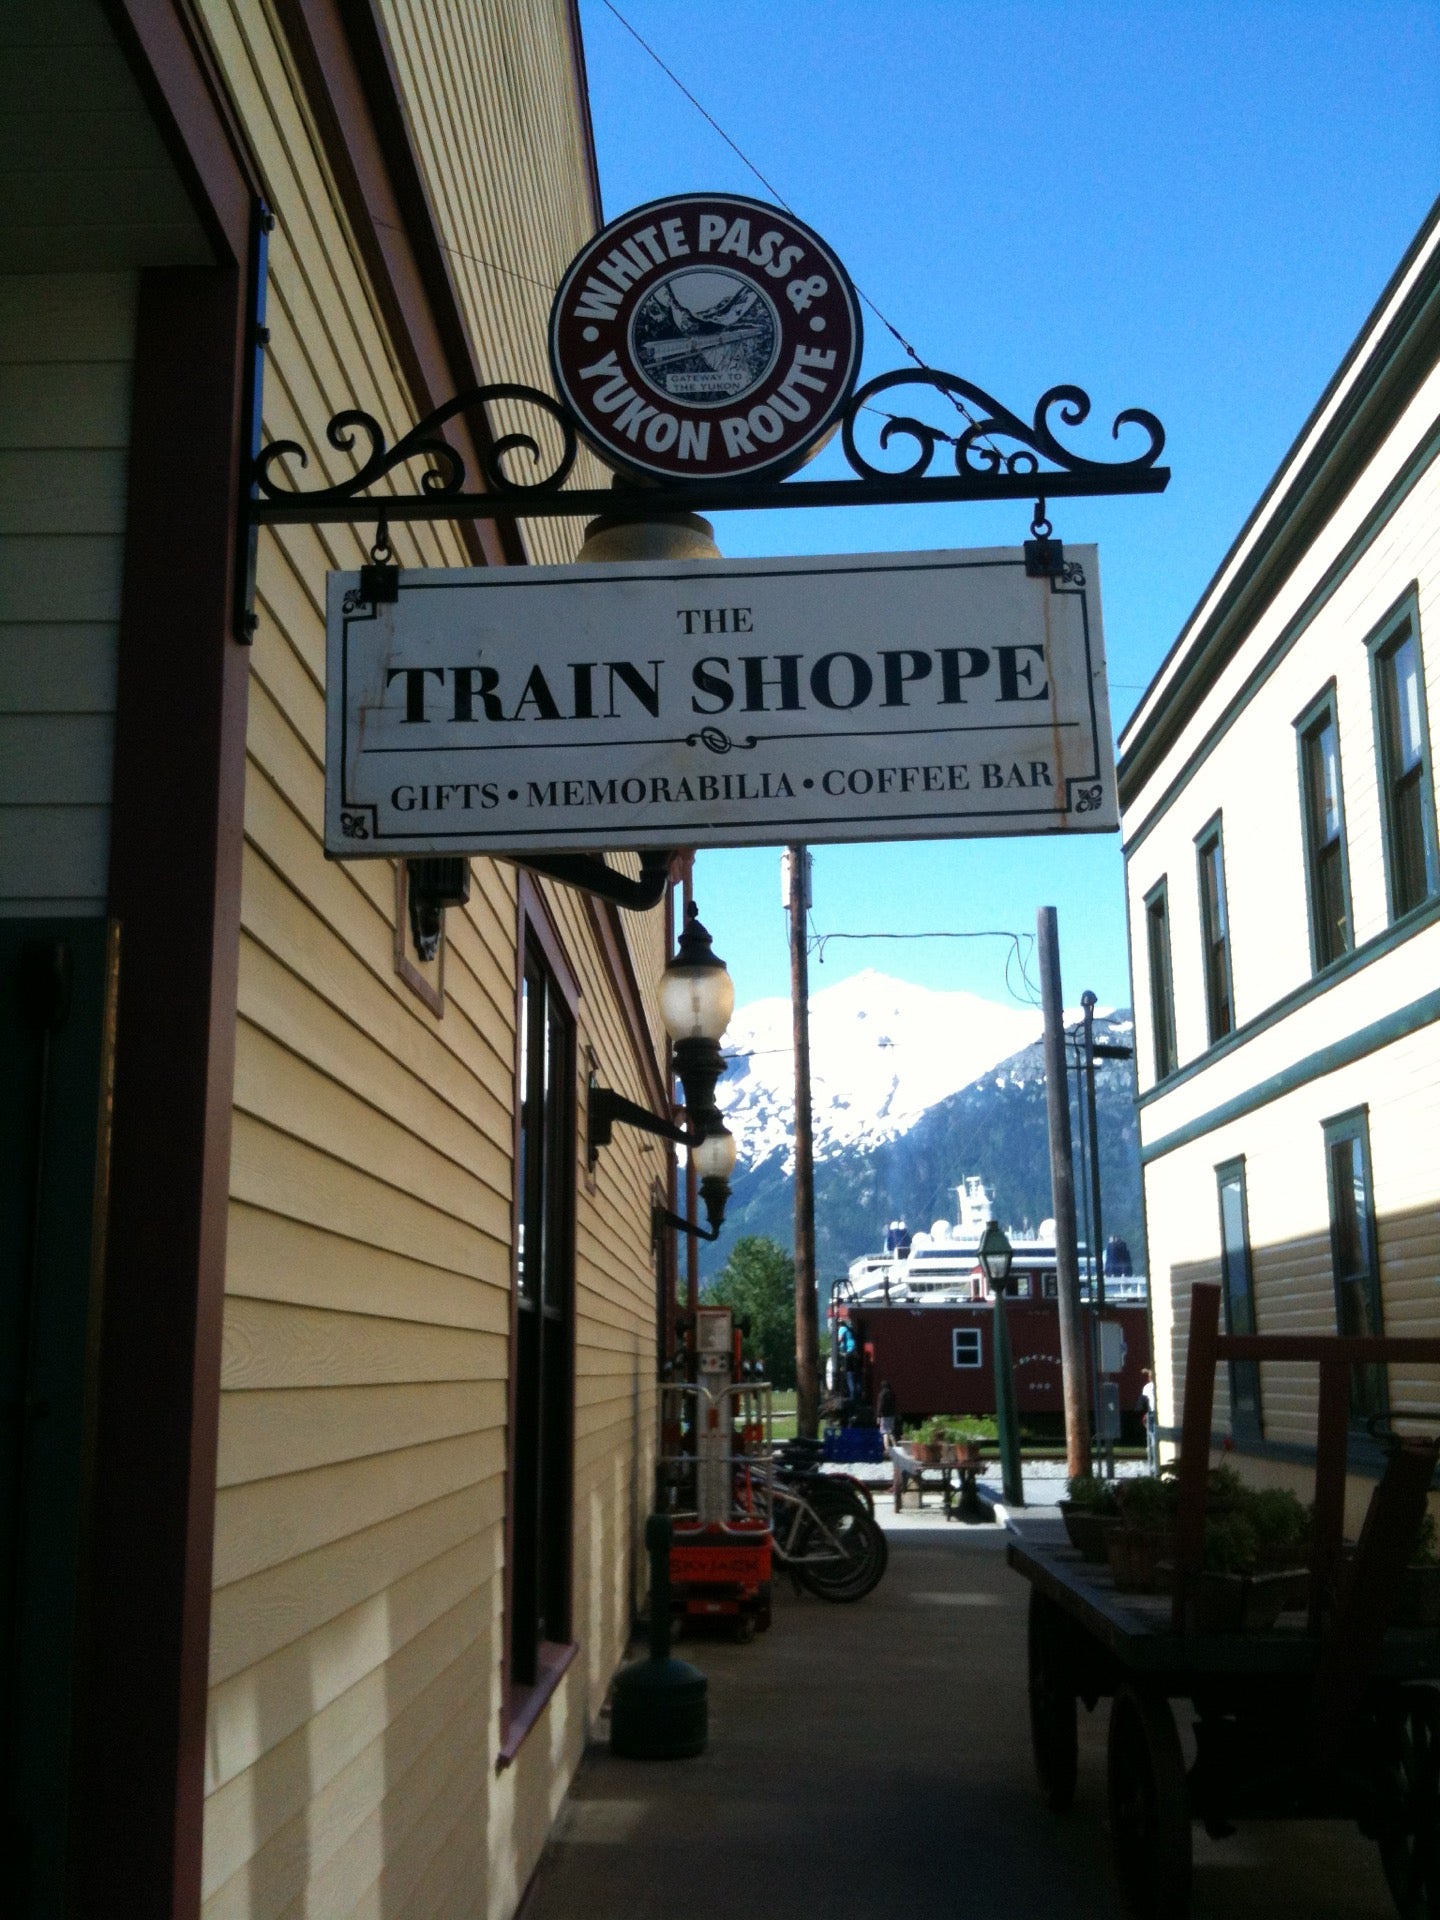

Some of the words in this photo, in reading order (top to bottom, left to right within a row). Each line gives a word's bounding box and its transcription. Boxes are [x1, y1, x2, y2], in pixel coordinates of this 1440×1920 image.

[574, 217, 690, 321] WHITE
[698, 214, 806, 278] PASS
[786, 275, 828, 314] &
[578, 349, 711, 461] YUKON
[719, 344, 837, 458] ROUTE
[671, 373, 722, 382] GATEWAY
[728, 373, 742, 381] TO
[673, 383, 695, 391] THE
[700, 382, 741, 391] YUKON
[677, 607, 754, 635] THE
[386, 659, 665, 724] TRAIN
[691, 643, 1050, 716] SHOPPE
[390, 782, 500, 812] GIFTS
[526, 771, 797, 807] MEMORABILIA
[822, 763, 970, 796] COFFEE
[982, 761, 1054, 788] BAR
